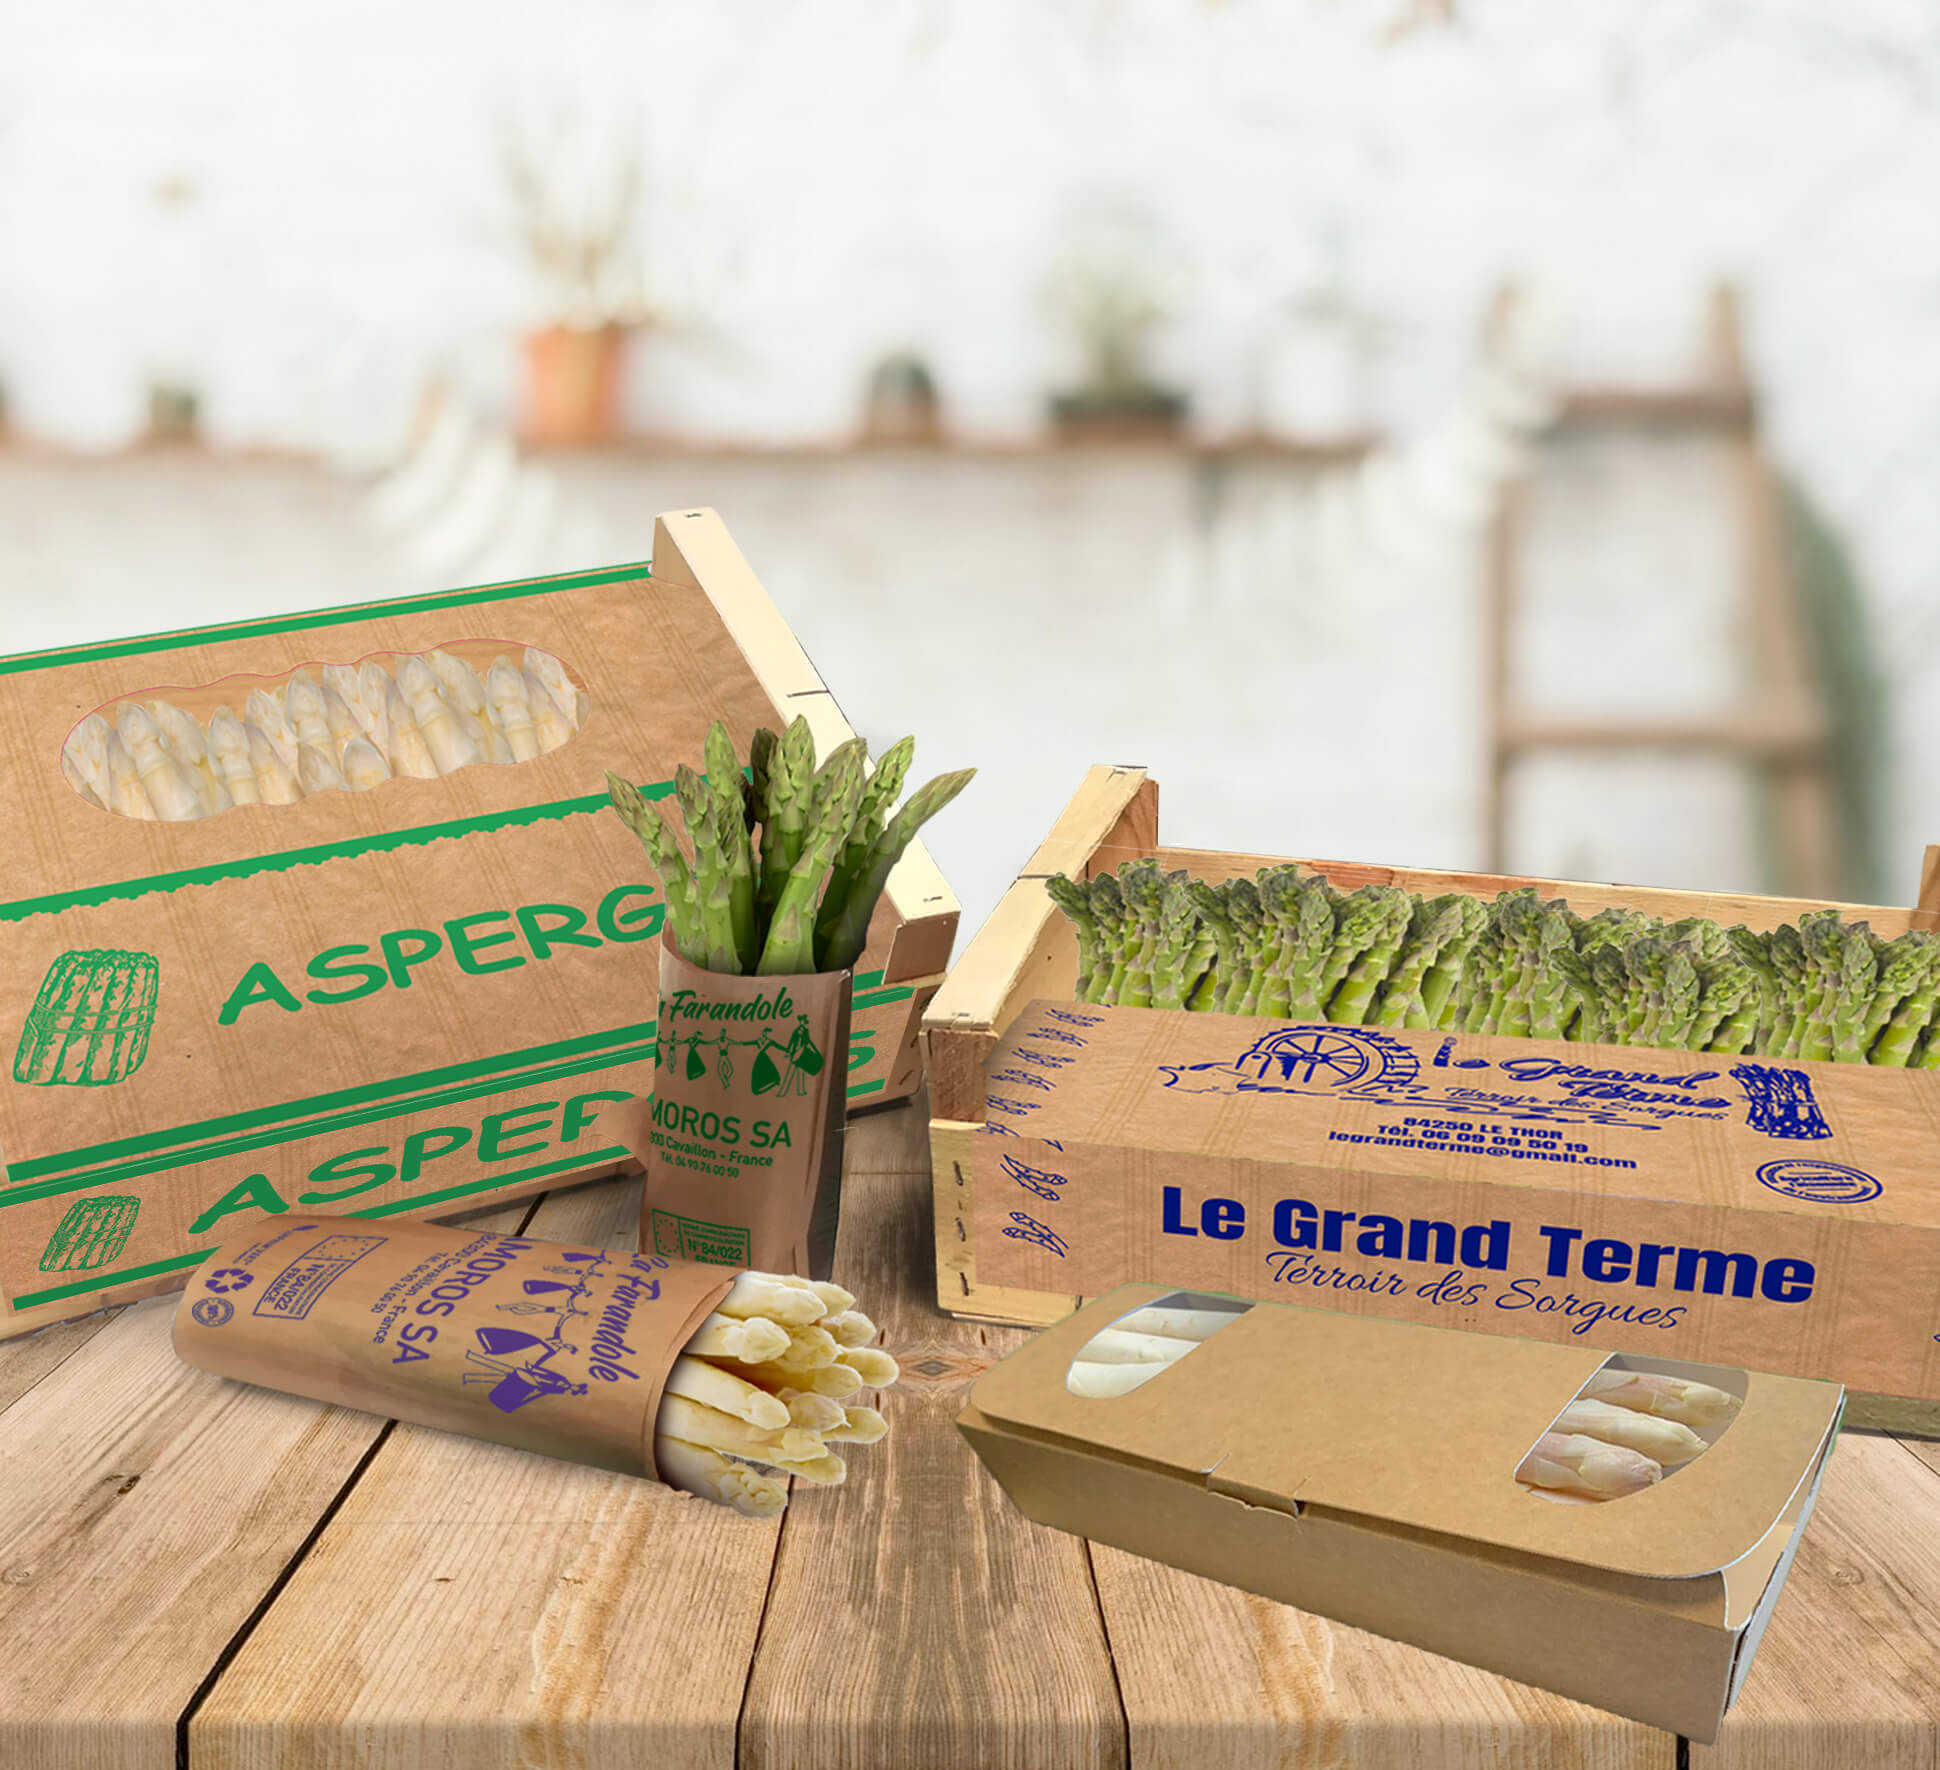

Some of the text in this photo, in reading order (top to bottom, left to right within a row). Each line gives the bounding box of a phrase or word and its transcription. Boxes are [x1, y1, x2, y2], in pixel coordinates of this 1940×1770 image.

[669, 986, 793, 1022] Farandole
[1499, 1058, 1721, 1089] Grand
[1402, 1117, 1563, 1140] 84250 LE THOR
[1600, 1101, 1729, 1121] Sorgues
[666, 1136, 716, 1160] Cavaillon
[729, 1150, 774, 1167] France
[749, 1120, 792, 1149] SA
[1328, 1131, 1637, 1169] legrandterme@gmail.com
[1421, 1129, 1451, 1141] 06
[1456, 1132, 1485, 1144] 09
[1491, 1135, 1521, 1147] 09
[1528, 1138, 1557, 1151] 50
[1564, 1142, 1589, 1153] 19
[712, 1164, 725, 1176] 00
[1162, 1185, 1816, 1304] Le Grand Terme
[404, 1257, 461, 1297] Cavaillon
[392, 1237, 533, 1364] MOROS SA
[1416, 1270, 1488, 1306] des
[1495, 1278, 1688, 1335] Sorgues
[373, 1304, 407, 1344] France
[588, 1274, 660, 1382] Farandole
